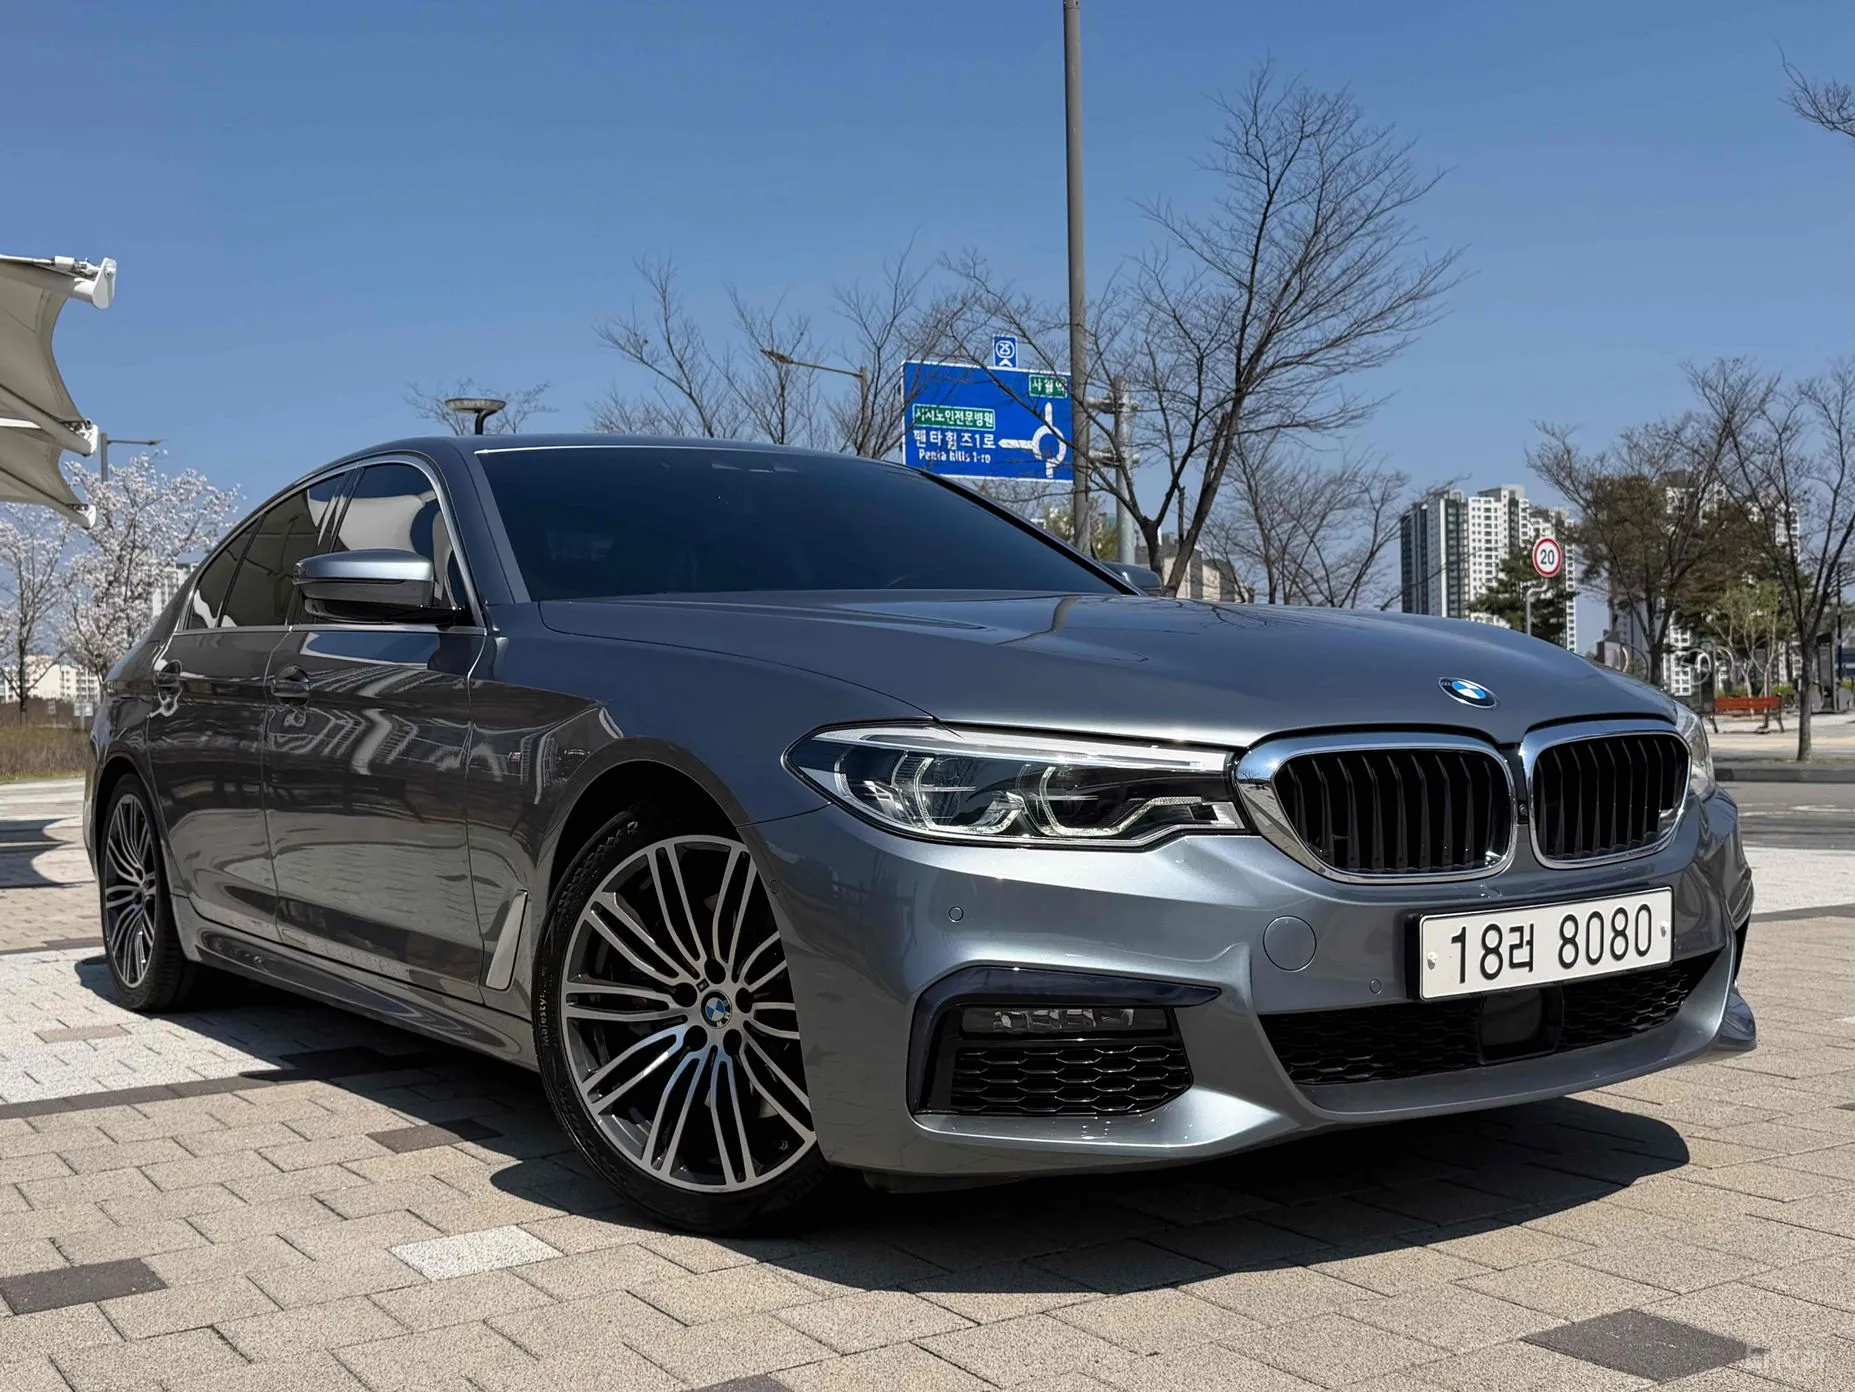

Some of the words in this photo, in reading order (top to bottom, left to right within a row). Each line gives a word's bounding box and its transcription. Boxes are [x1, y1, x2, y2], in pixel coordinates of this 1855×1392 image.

[1000, 343, 1010, 355] 25
[1540, 549, 1554, 565] 20
[1451, 922, 1535, 985] 18러
[1557, 903, 1652, 971] 8080
